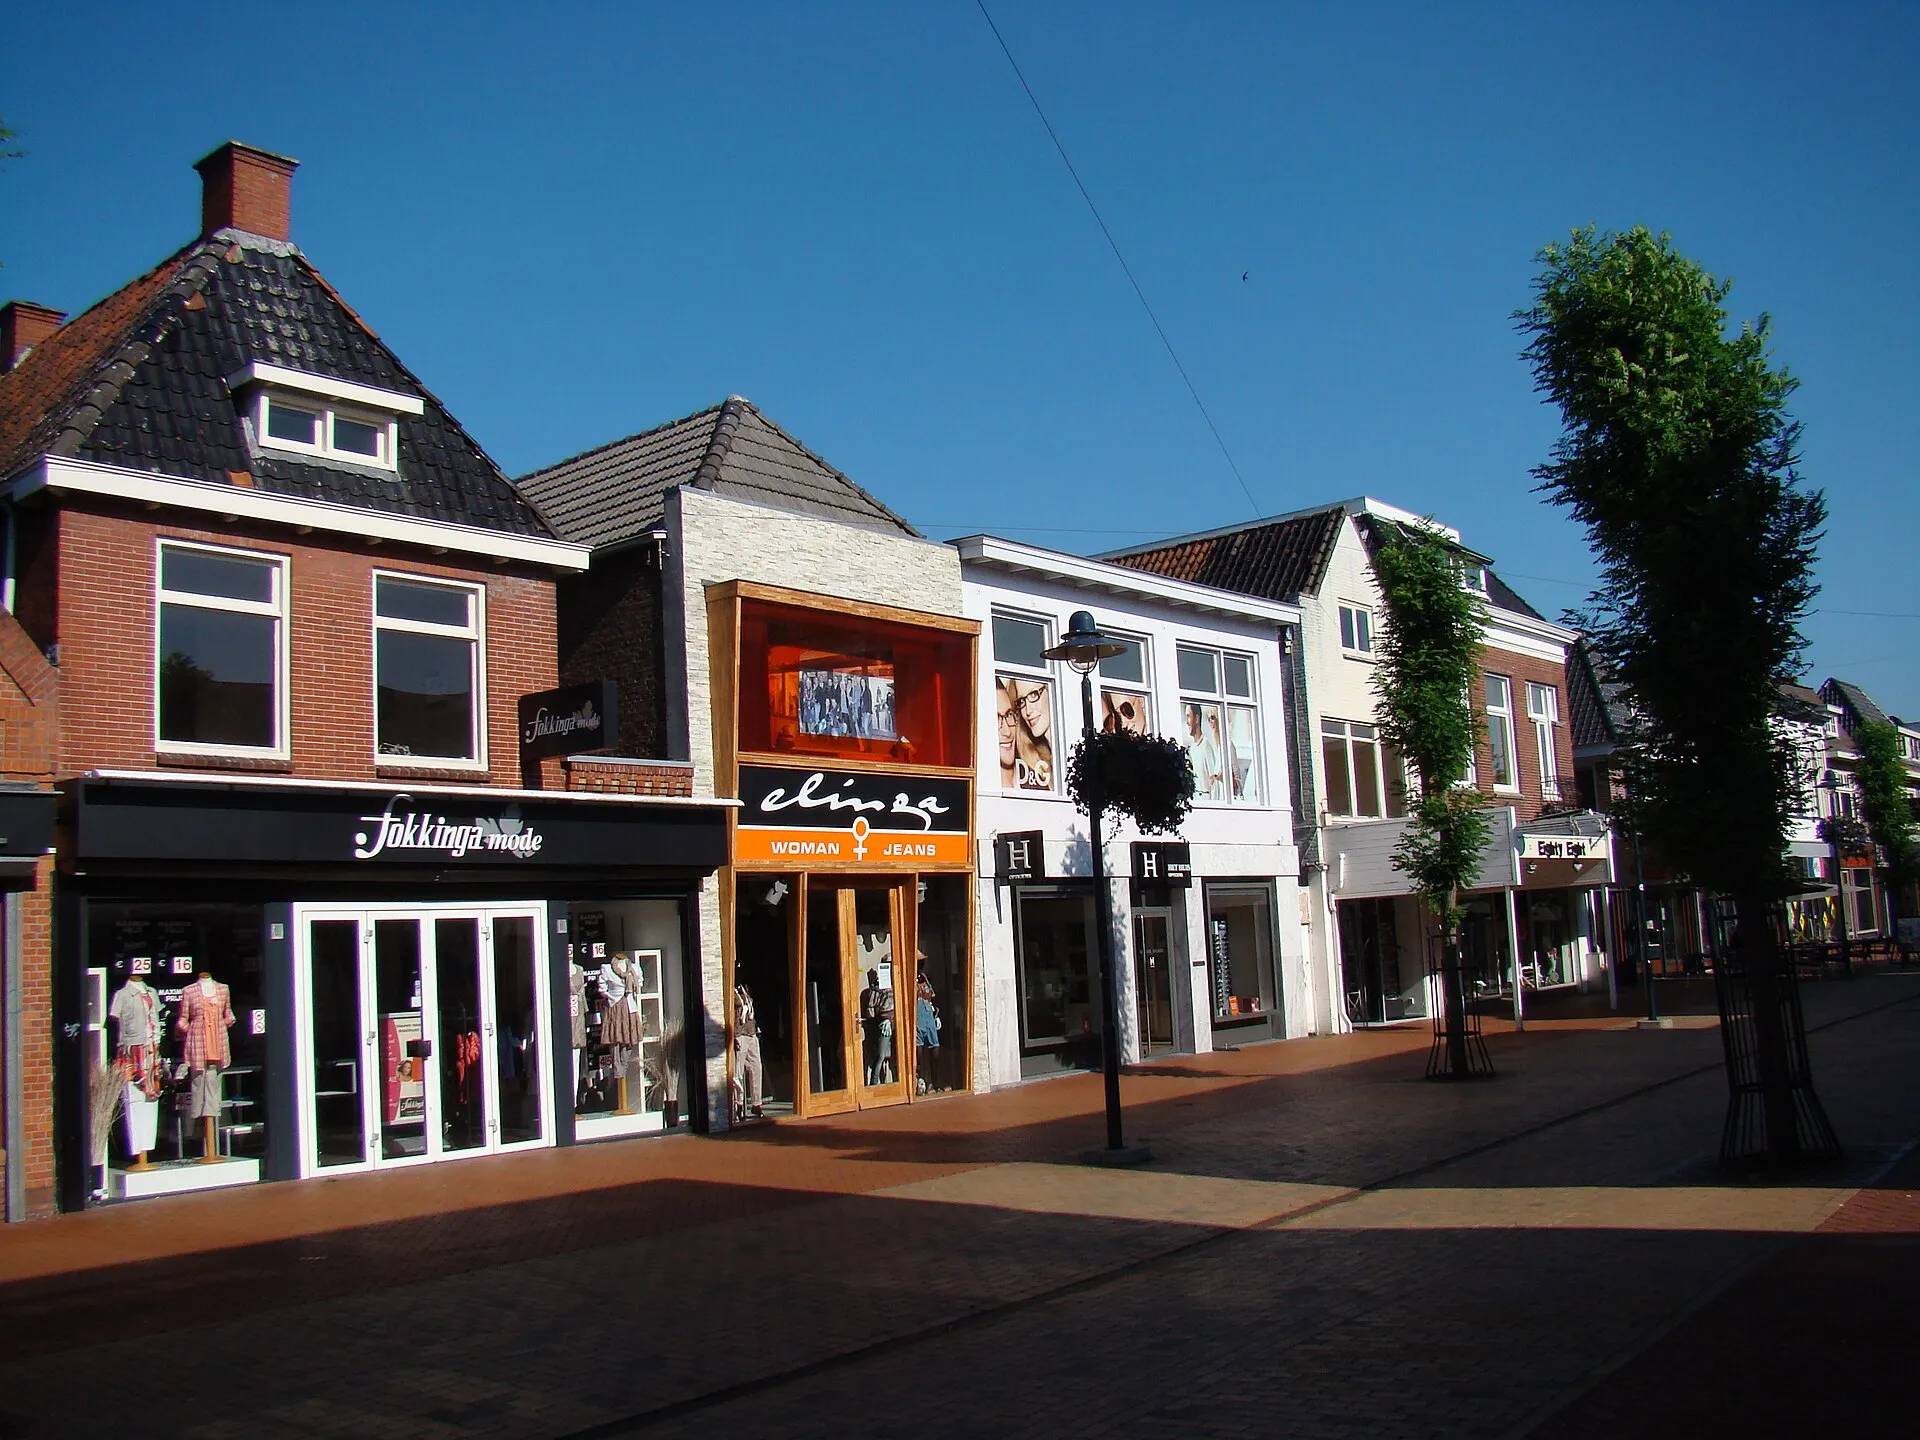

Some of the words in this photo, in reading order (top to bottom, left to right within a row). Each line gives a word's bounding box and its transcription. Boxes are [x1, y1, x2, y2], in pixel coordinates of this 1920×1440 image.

[1015, 758, 1051, 787] D&G
[487, 828, 543, 851] mode
[770, 841, 840, 855] WOMAN
[883, 843, 936, 856] JEANS
[1007, 839, 1032, 870] H
[1142, 852, 1159, 878] H
[594, 945, 604, 955] 16
[115, 960, 124, 968] €
[134, 959, 151, 971] 25
[157, 959, 166, 967] €
[175, 958, 192, 971] 16
